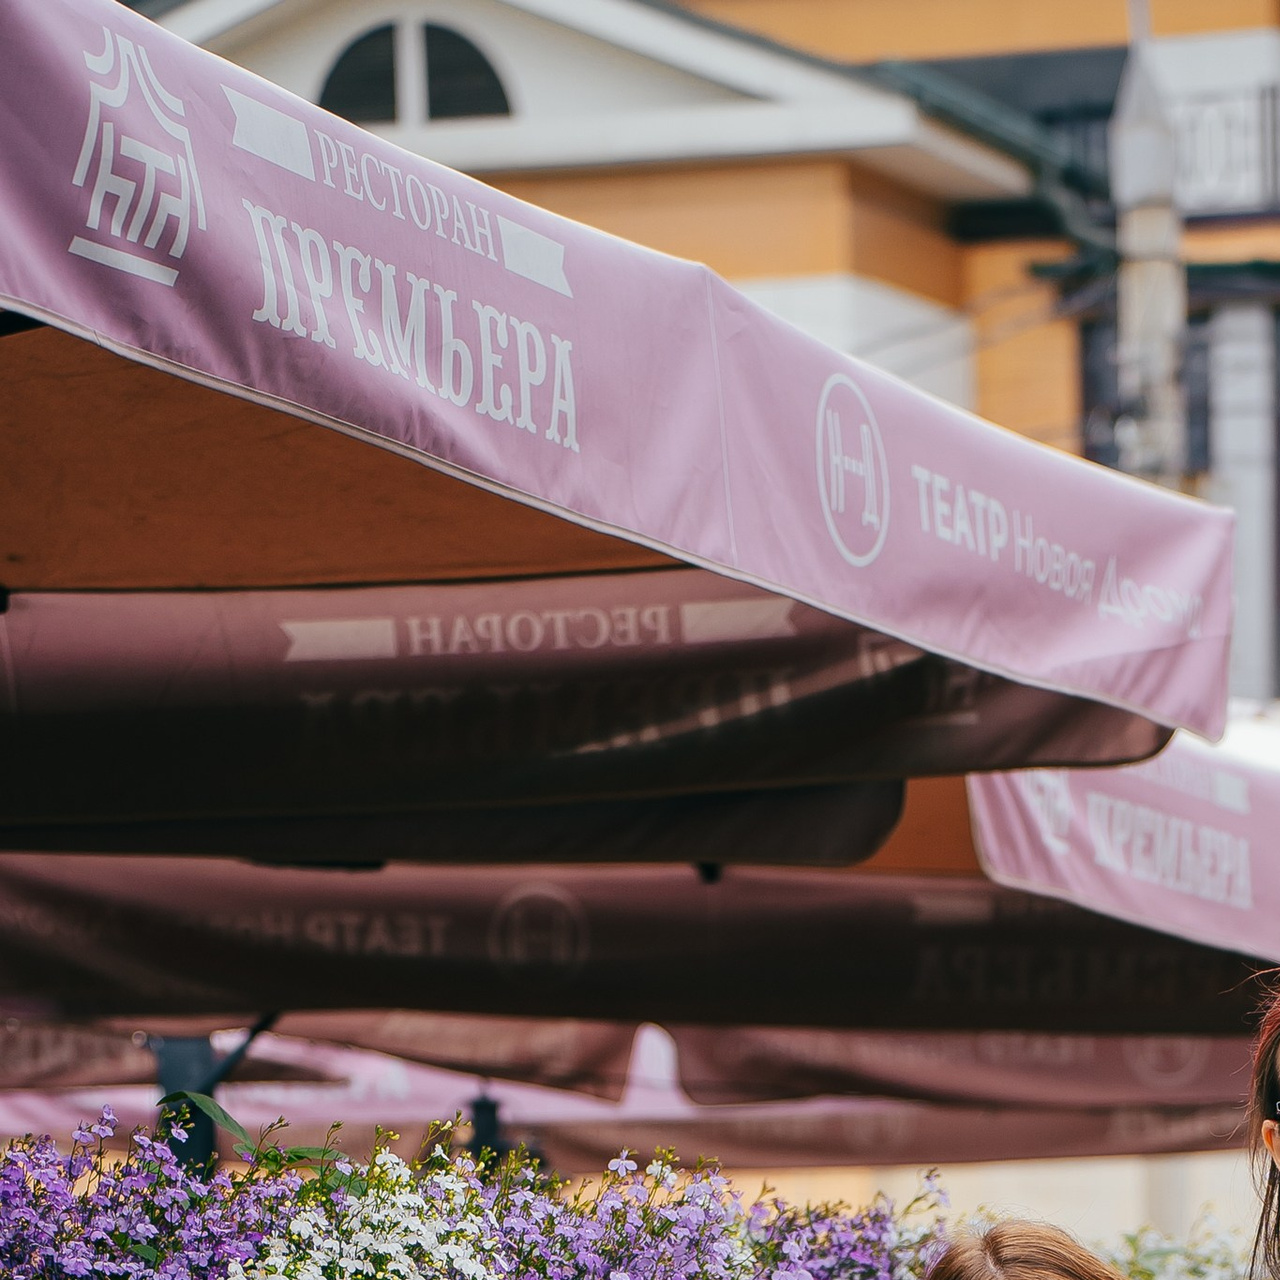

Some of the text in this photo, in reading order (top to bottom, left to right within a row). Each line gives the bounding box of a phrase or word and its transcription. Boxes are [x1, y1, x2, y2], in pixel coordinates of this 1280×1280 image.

[314, 128, 500, 262] РЕСТОРАН
[242, 197, 580, 453] ПРЕМЬЕРА
[911, 464, 1008, 561] ТЕАТР
